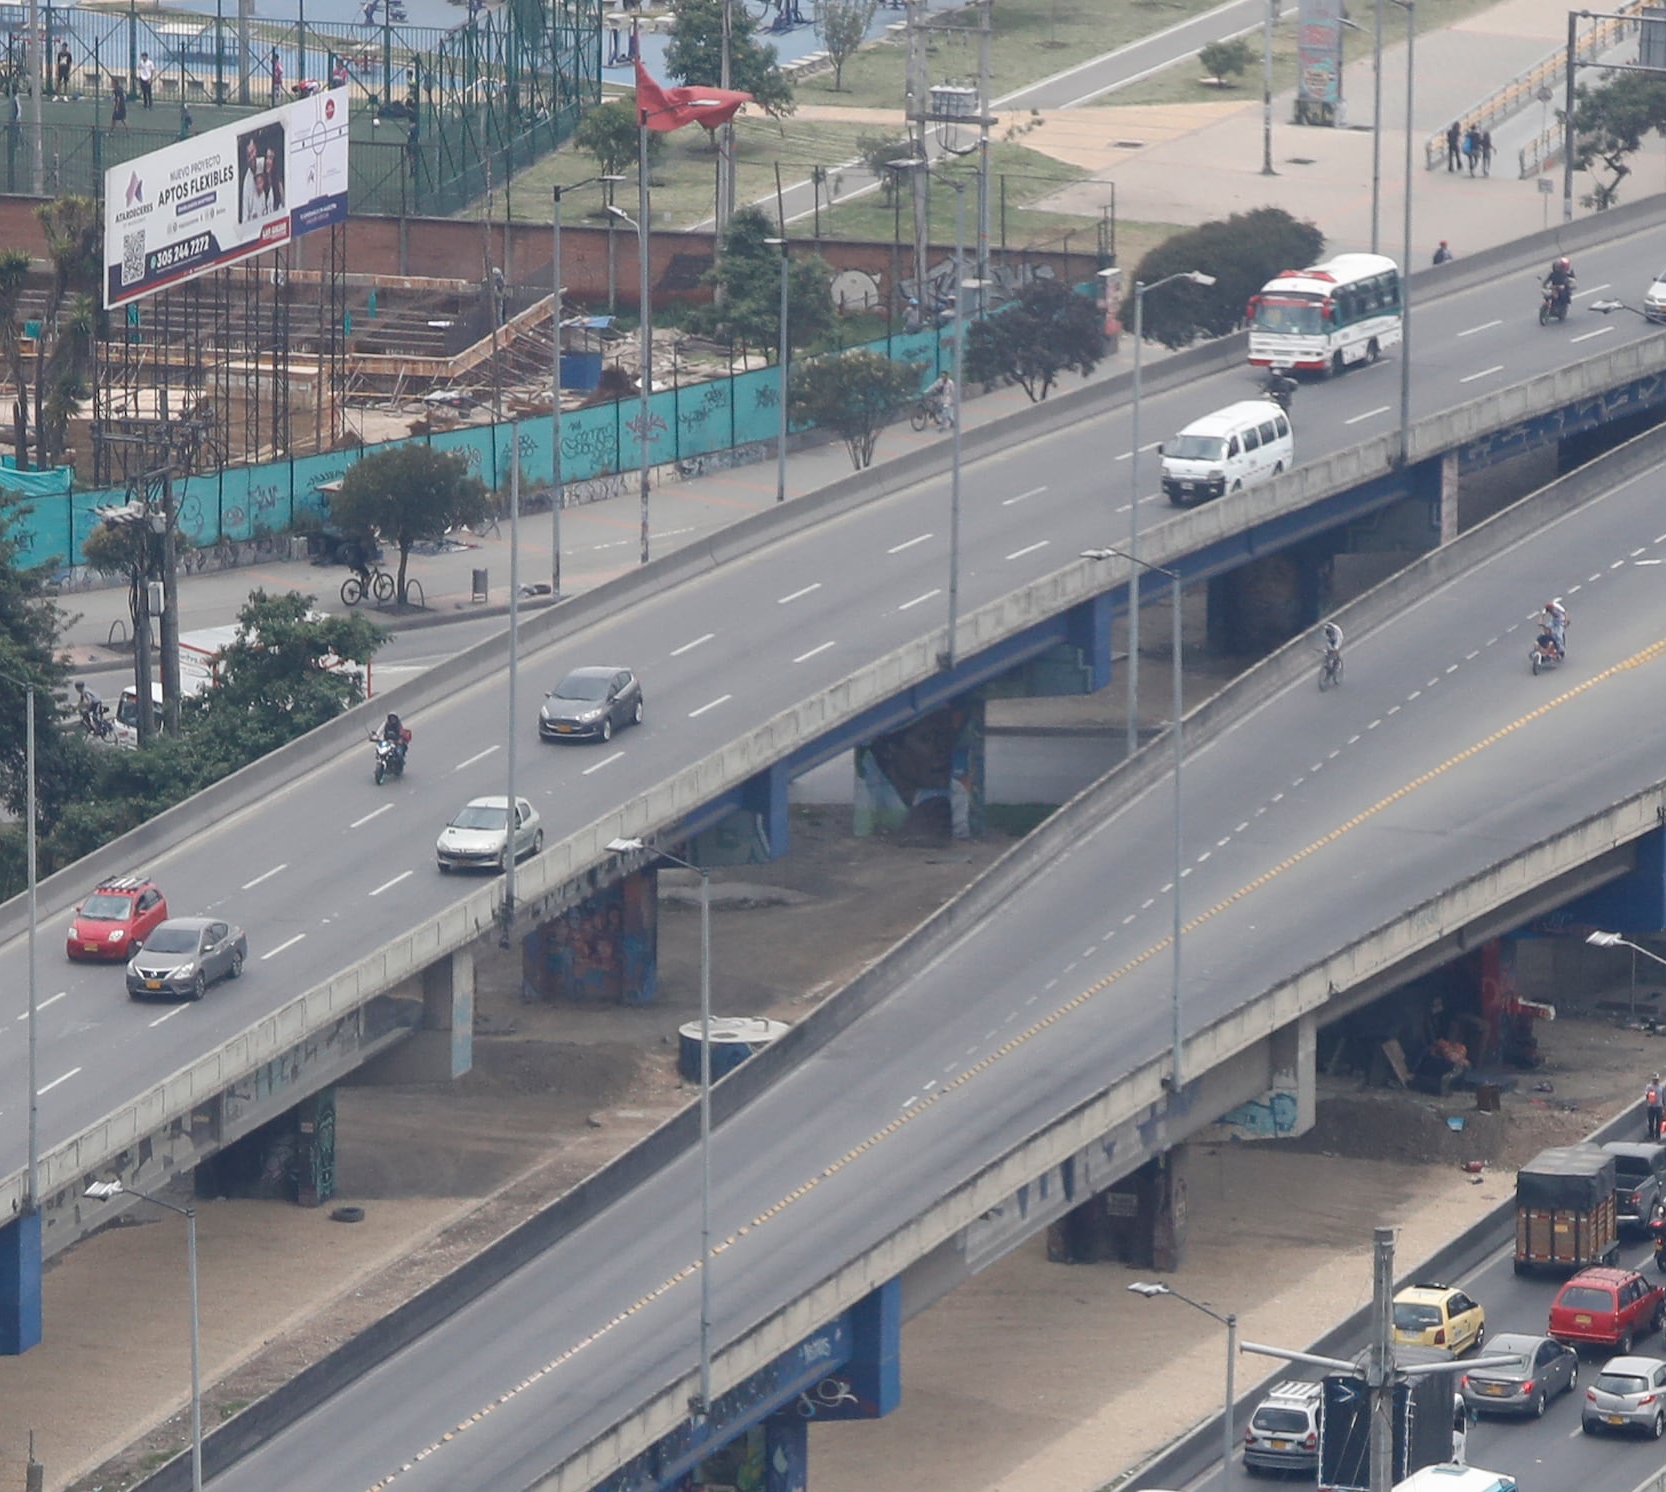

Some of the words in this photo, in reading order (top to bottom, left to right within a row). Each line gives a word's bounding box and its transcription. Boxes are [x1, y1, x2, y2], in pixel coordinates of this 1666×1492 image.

[191, 154, 221, 175] PROYECTO
[158, 181, 189, 208] APTOS
[190, 165, 234, 195] FLEXIBLES
[156, 249, 173, 268] 305
[173, 242, 190, 262] 244
